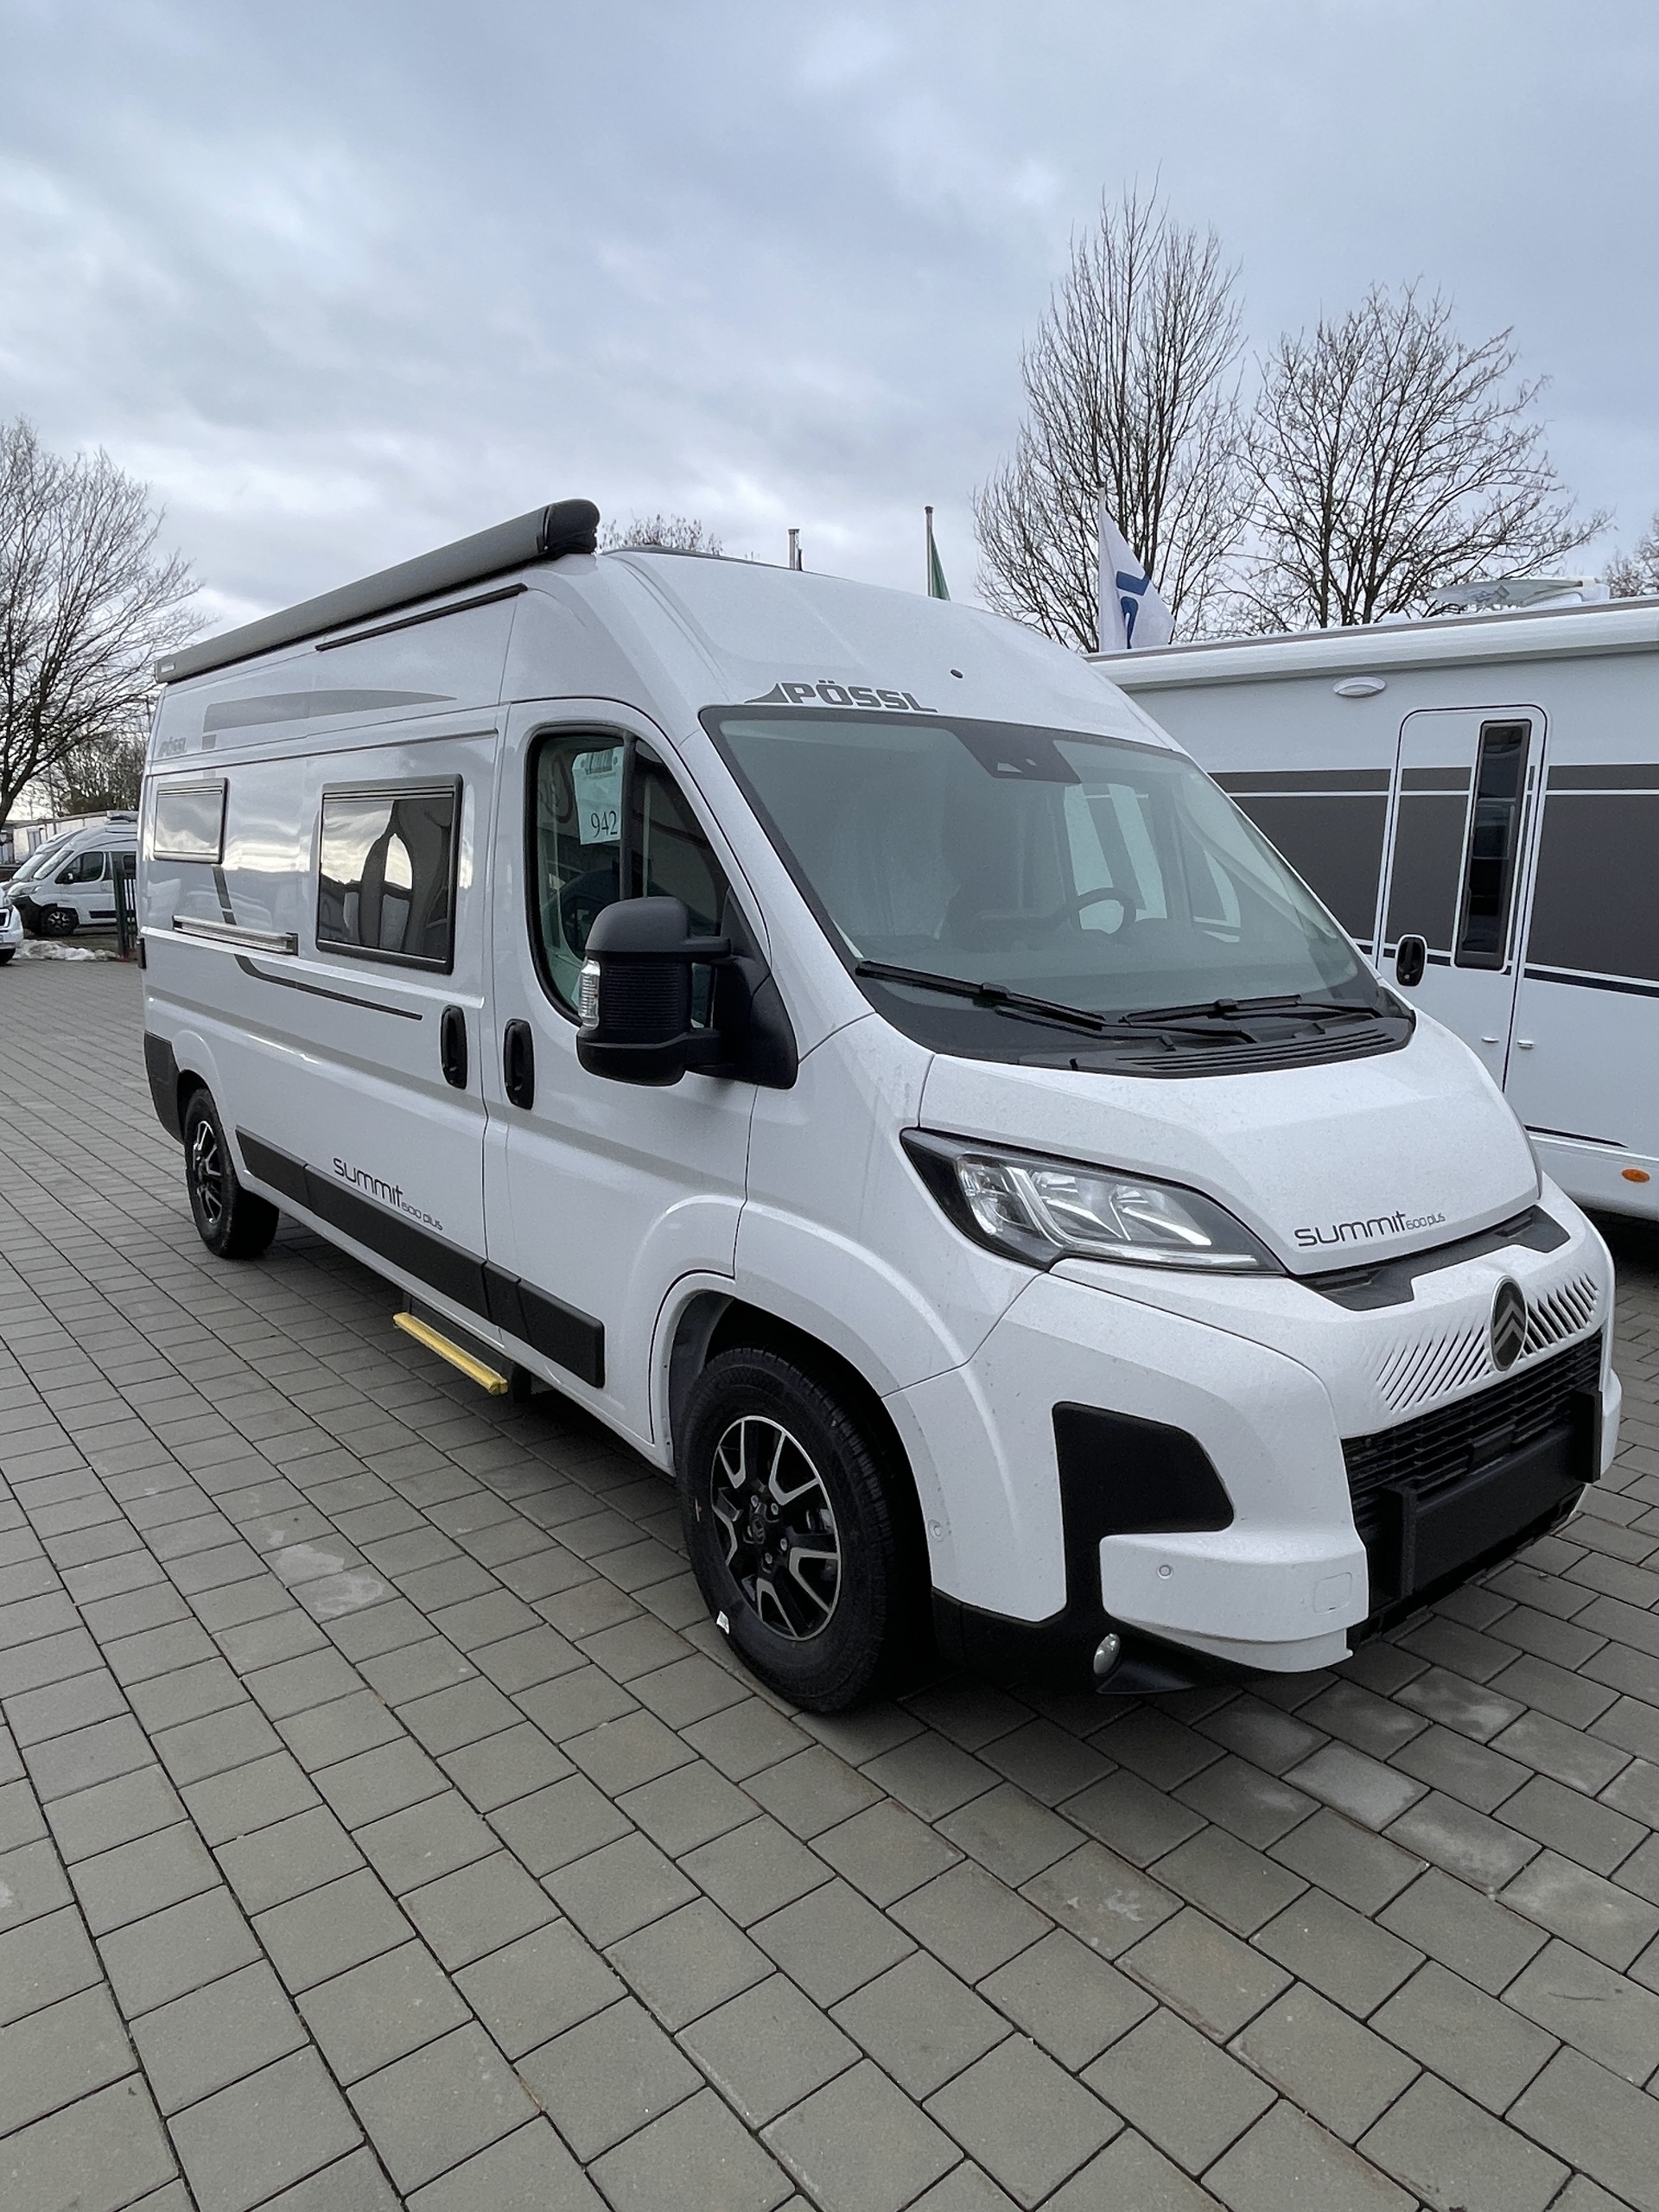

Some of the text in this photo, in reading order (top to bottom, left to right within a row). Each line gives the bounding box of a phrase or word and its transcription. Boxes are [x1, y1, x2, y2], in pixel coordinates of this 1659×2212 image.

[780, 679, 938, 713] PÖSSL
[590, 810, 618, 838] 942
[333, 1157, 404, 1208] summit
[1294, 1211, 1446, 1247] summit 600 plus
